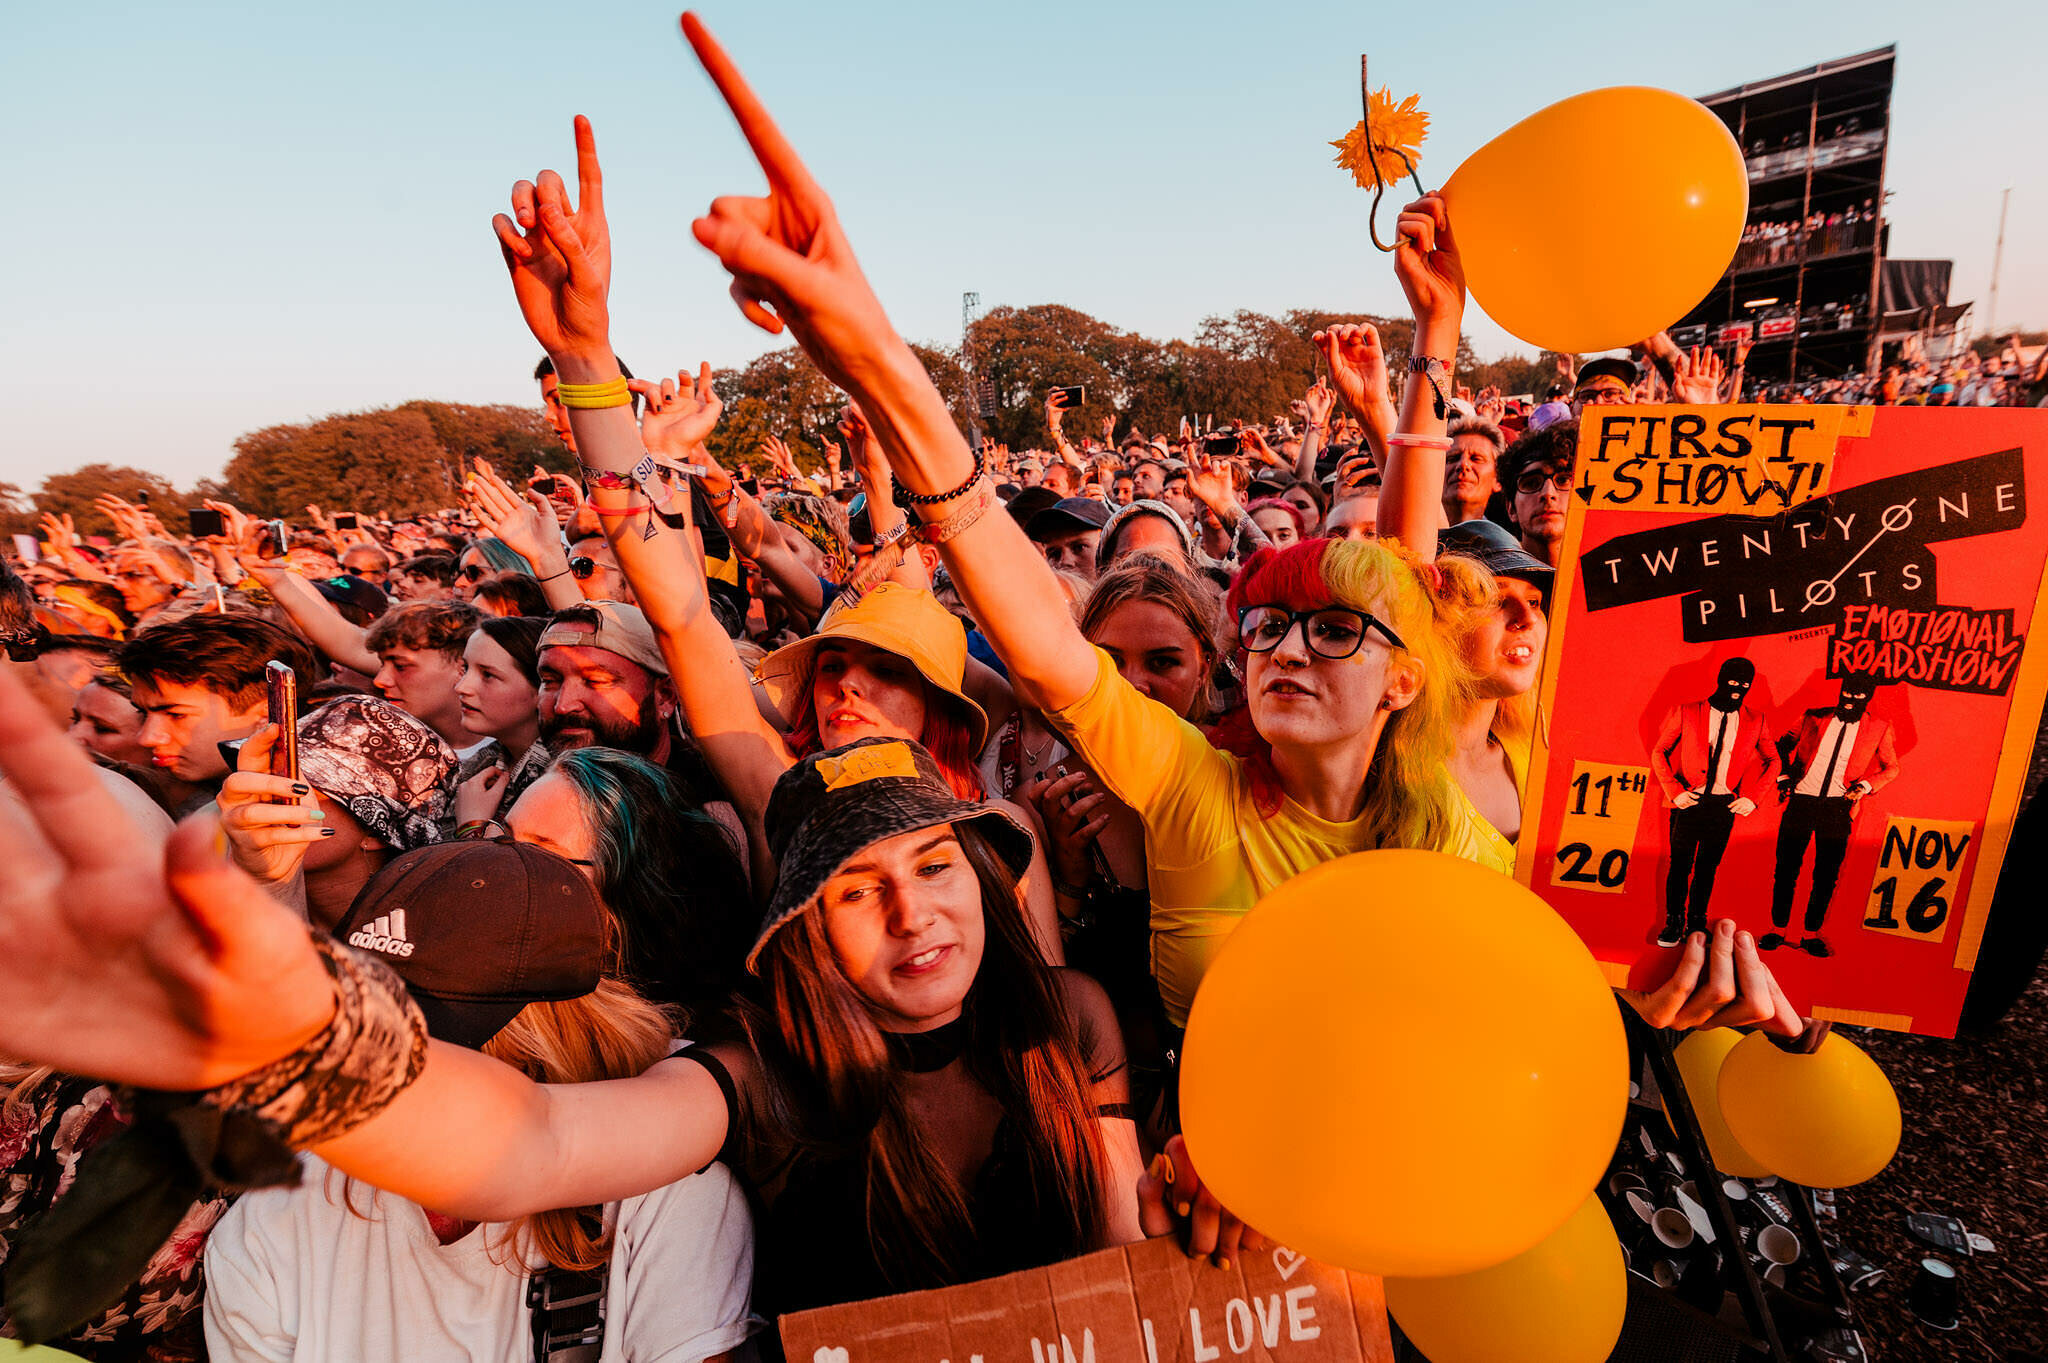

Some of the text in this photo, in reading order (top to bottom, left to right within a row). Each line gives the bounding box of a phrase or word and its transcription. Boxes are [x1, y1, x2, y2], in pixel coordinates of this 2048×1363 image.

[1590, 414, 1815, 462] FIRST
[1789, 628, 1829, 642] PRESENTS
[1556, 842, 1630, 887] 20
[1880, 825, 1970, 871] NOV
[1864, 876, 1948, 932] 16
[349, 931, 415, 957] adidas
[1190, 1284, 1321, 1362] LOVE
